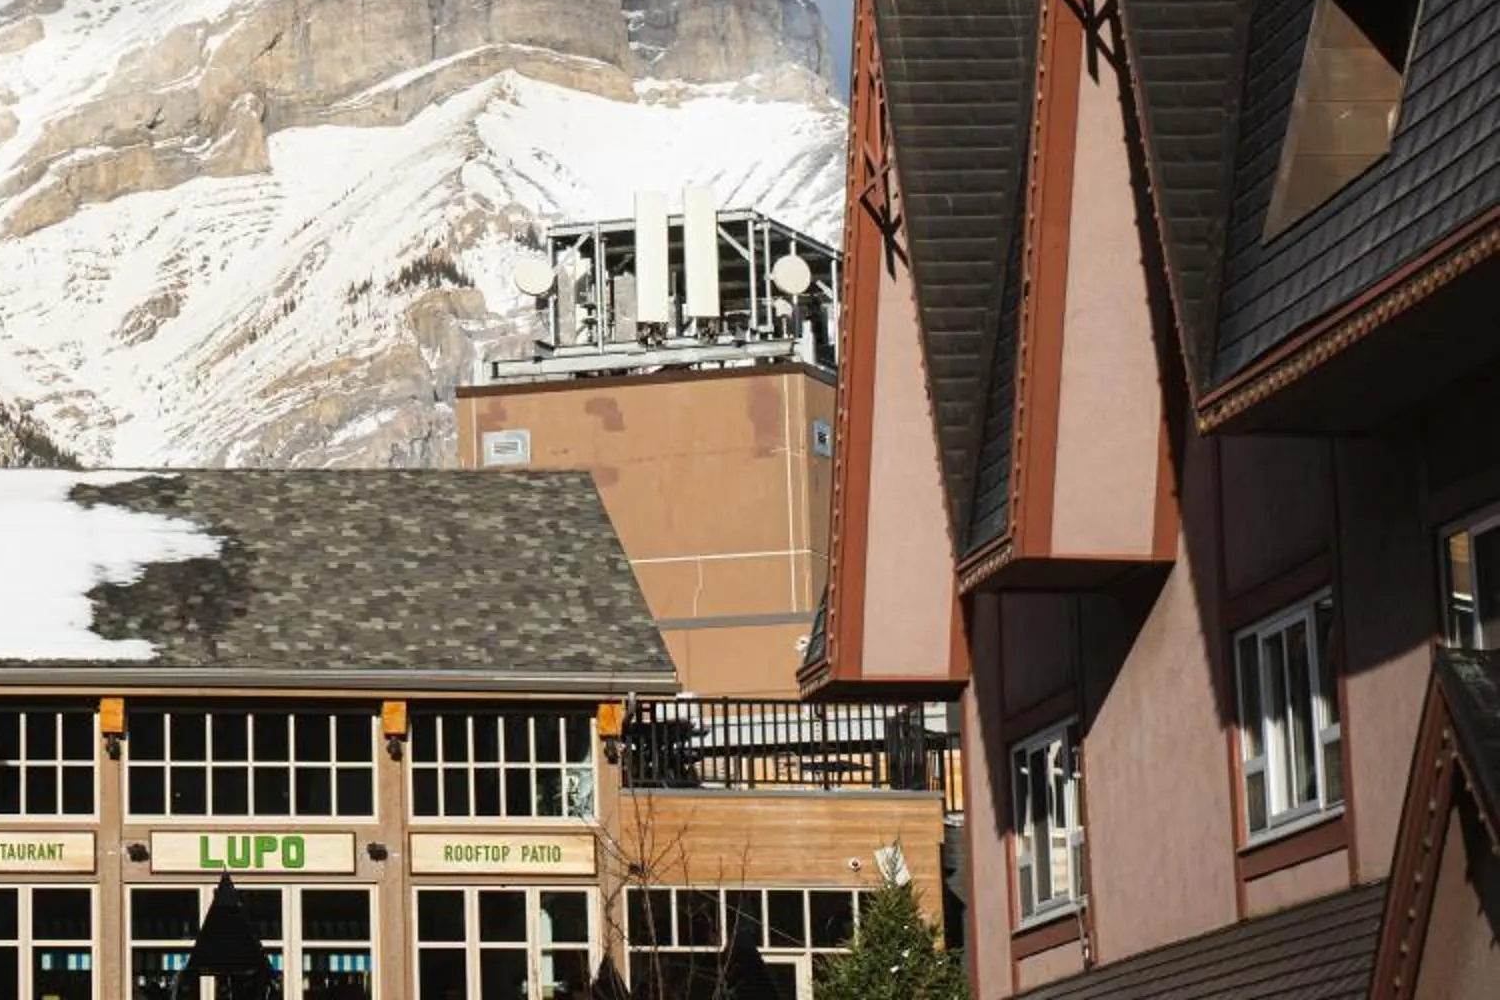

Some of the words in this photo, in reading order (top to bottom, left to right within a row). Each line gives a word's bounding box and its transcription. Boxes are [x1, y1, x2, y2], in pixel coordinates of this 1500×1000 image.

[199, 835, 305, 868] LUPO
[443, 844, 510, 863] ROOFTOP
[520, 844, 562, 863] PATIO
